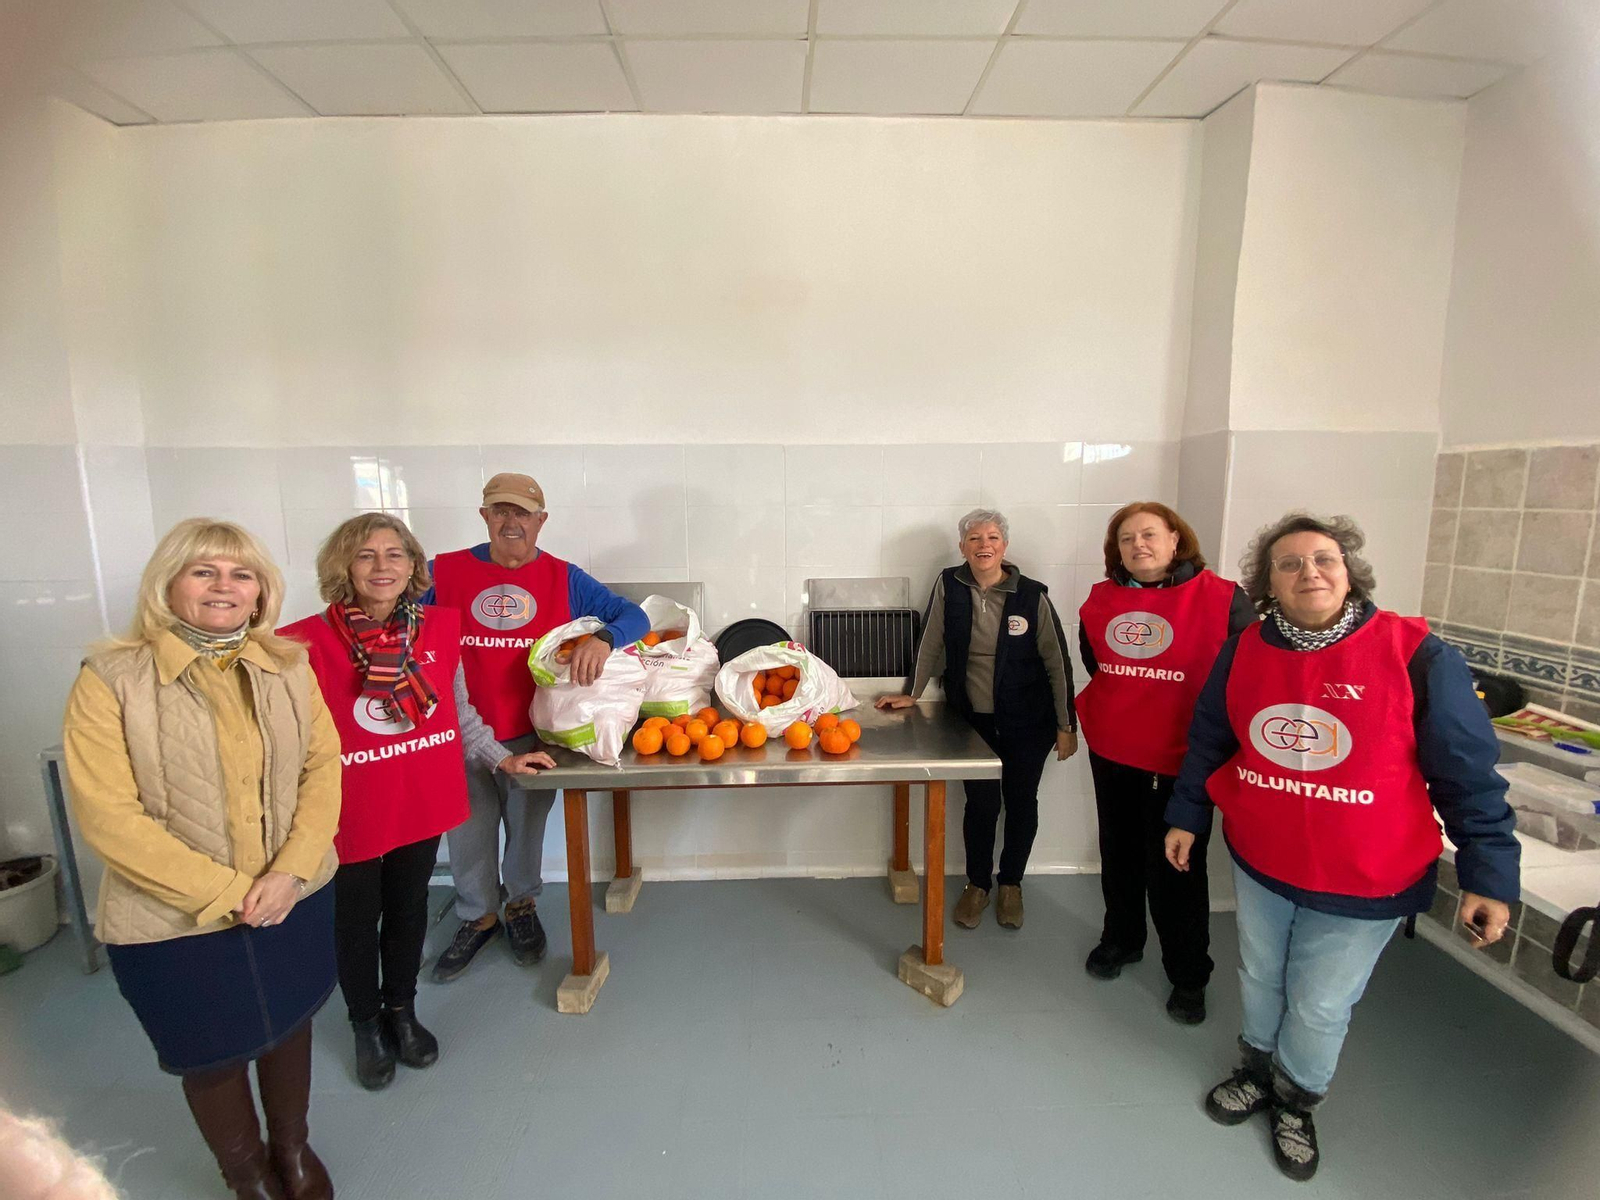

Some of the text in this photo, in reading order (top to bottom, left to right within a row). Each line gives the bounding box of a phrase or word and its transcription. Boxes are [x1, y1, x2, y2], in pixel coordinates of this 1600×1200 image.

[459, 635, 538, 648] VOLUNTAR
[643, 658, 665, 667] ción
[1098, 662, 1186, 682] VOLUNTARIO
[340, 729, 456, 767] VOLUNTARIO
[1236, 765, 1375, 805] VOLUNTARIO
